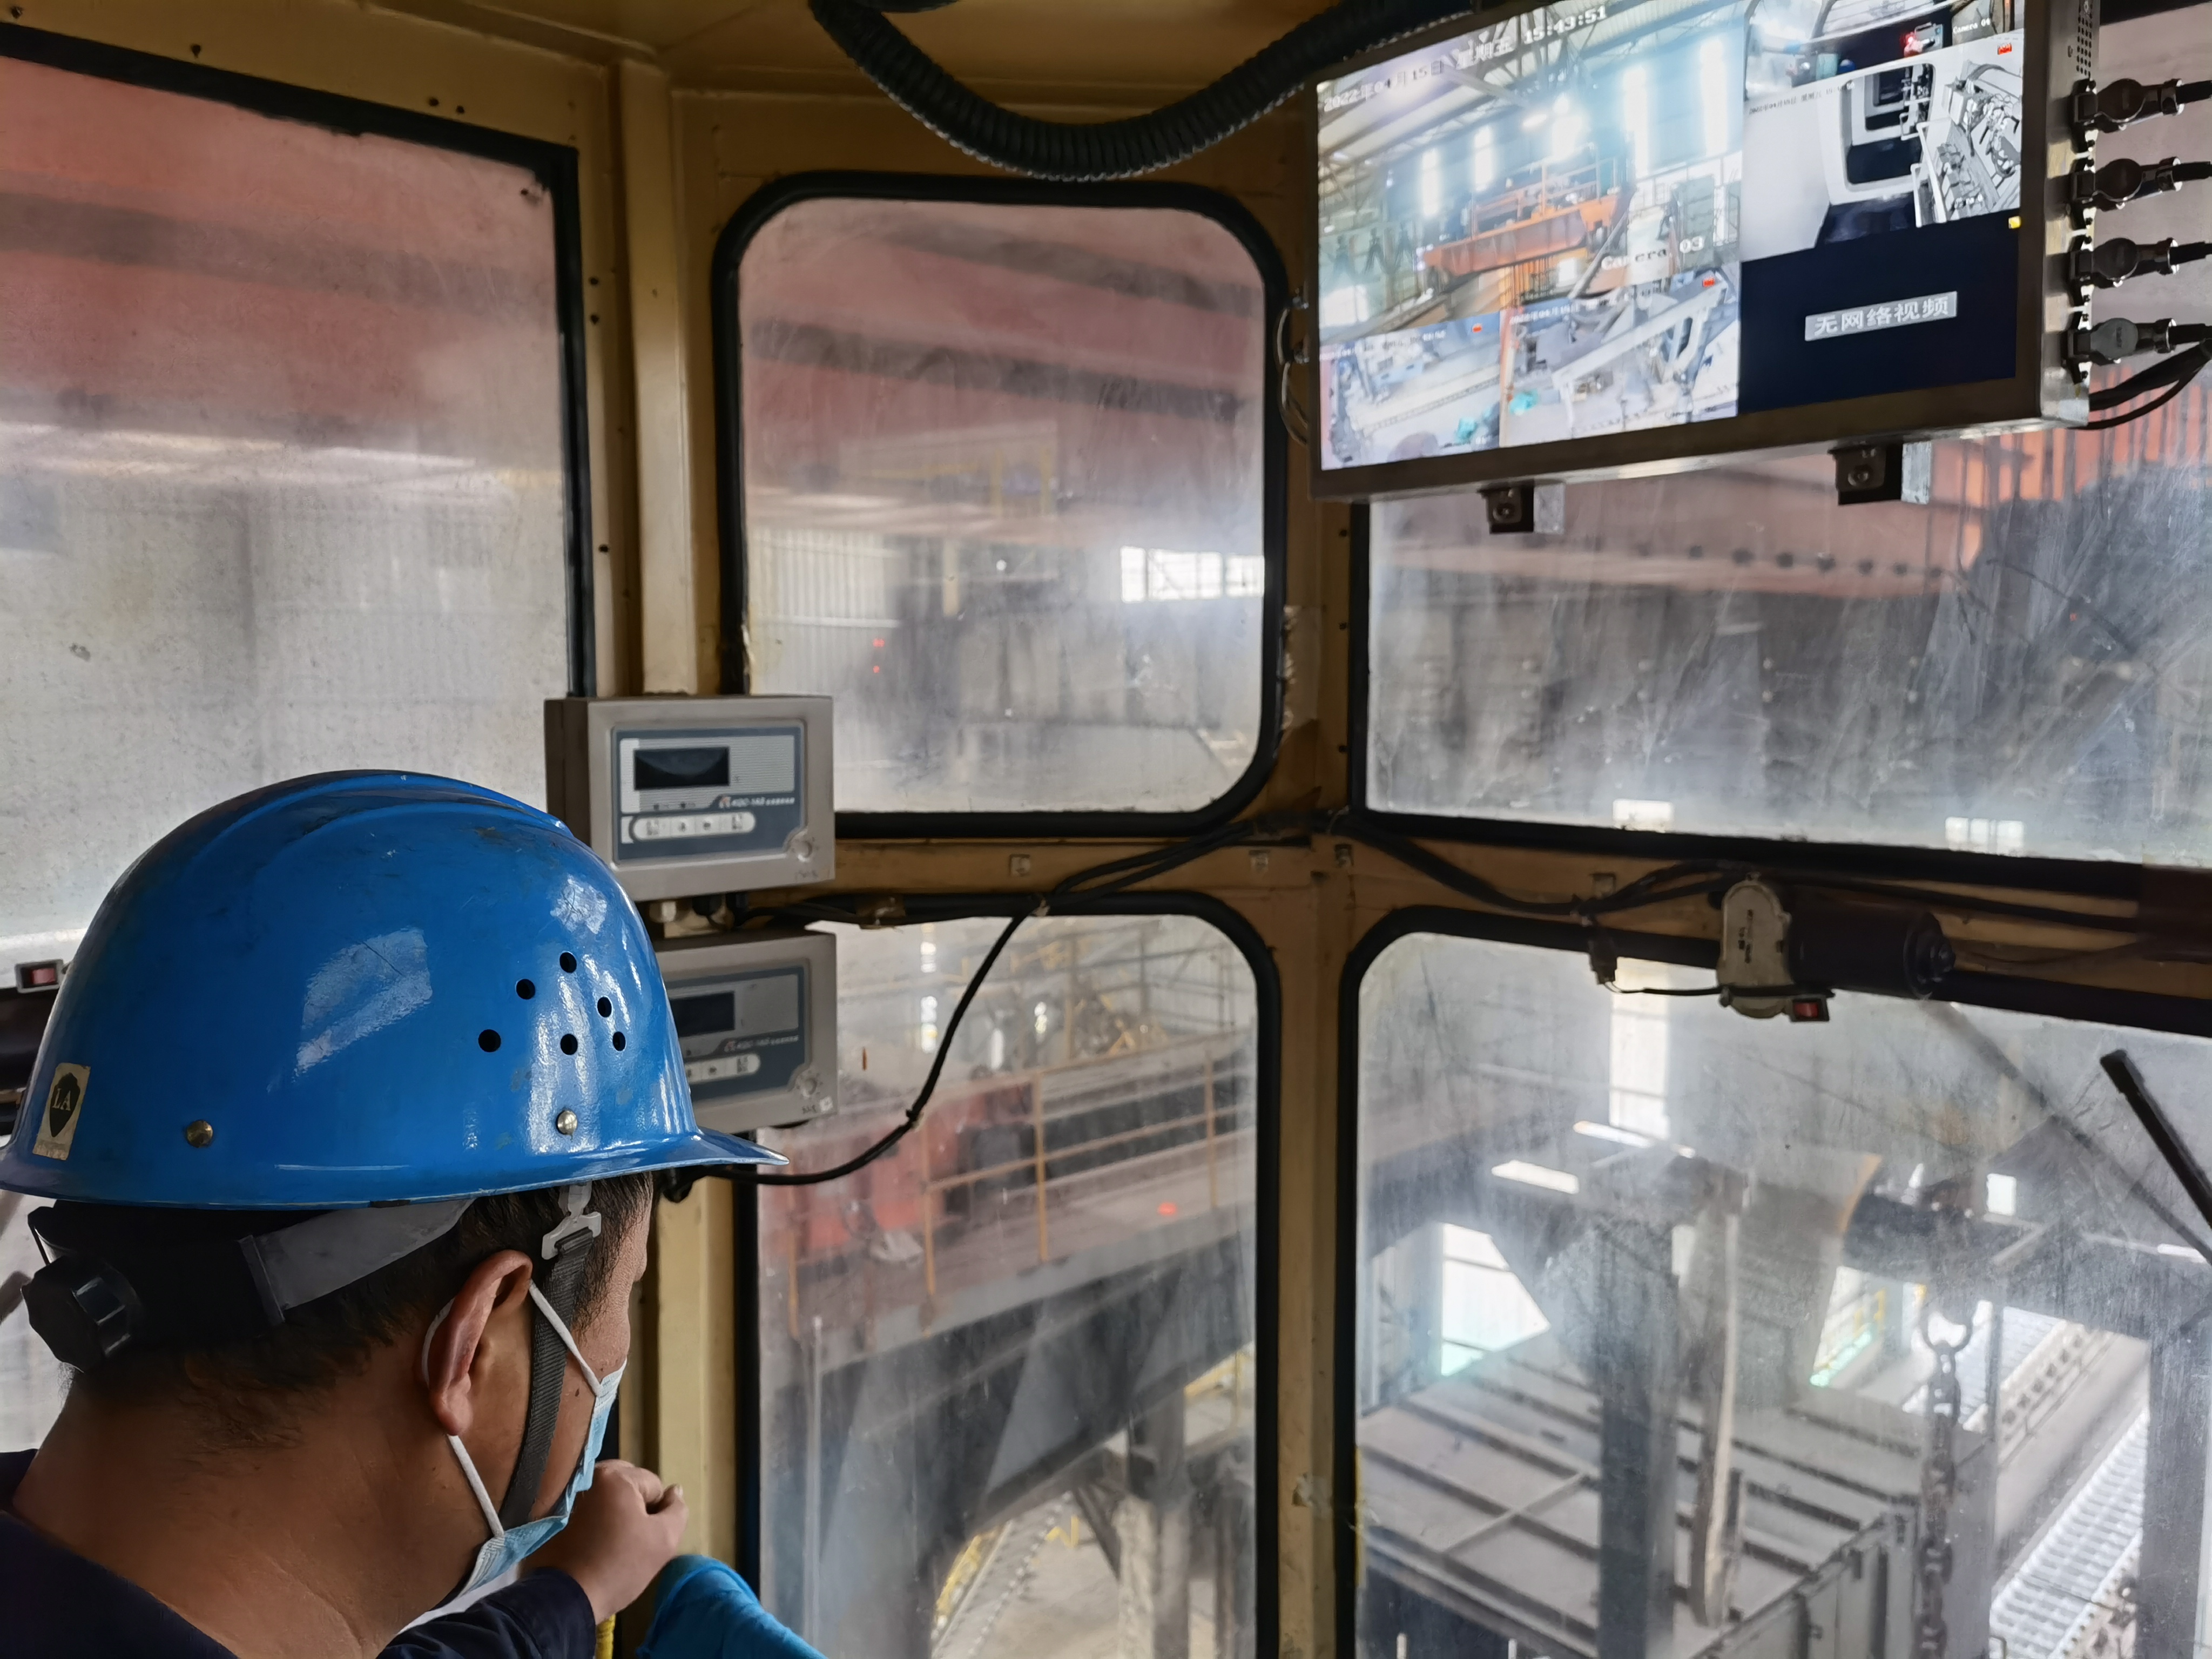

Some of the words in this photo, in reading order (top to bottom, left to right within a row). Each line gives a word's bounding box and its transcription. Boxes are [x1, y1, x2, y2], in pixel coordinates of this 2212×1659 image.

[1814, 296, 1949, 336] 无网络视频
[52, 1088, 71, 1111] LA
